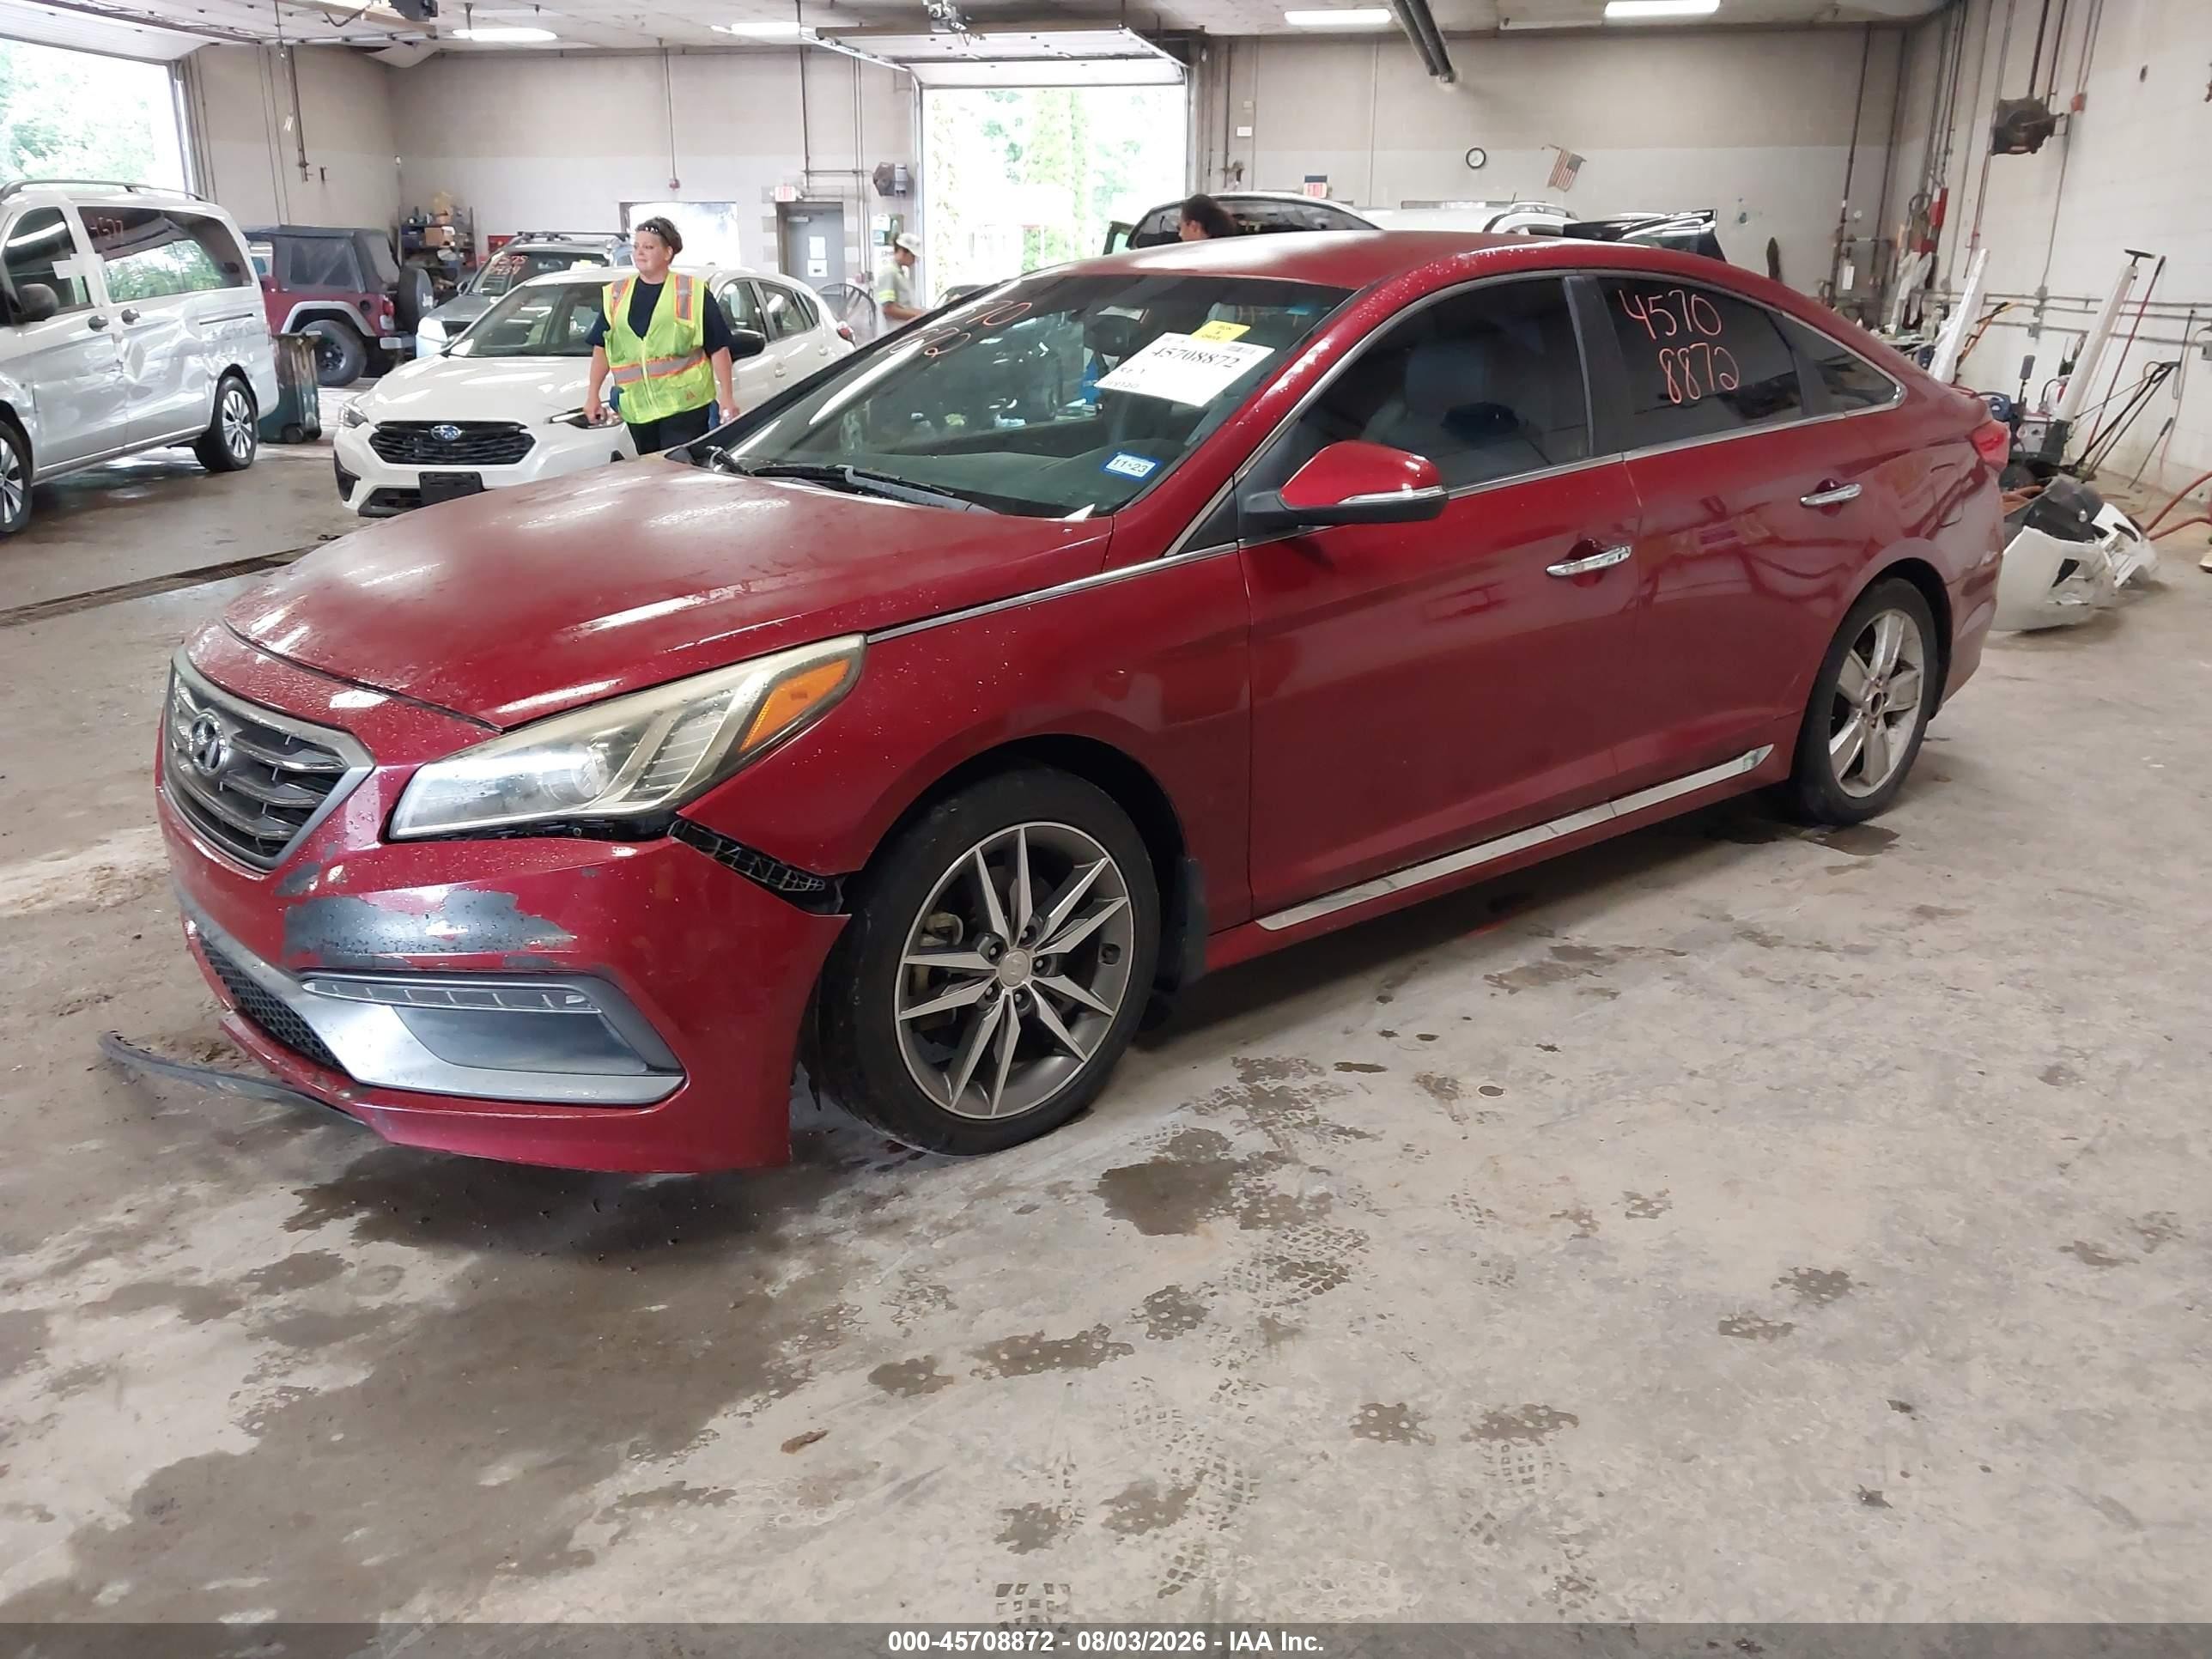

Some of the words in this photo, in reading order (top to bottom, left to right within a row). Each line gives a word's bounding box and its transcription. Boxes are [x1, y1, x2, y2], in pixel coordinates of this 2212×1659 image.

[1619, 289, 1722, 340] 4570
[1152, 346, 1241, 368] 45708872
[1658, 342, 1739, 404] 8872
